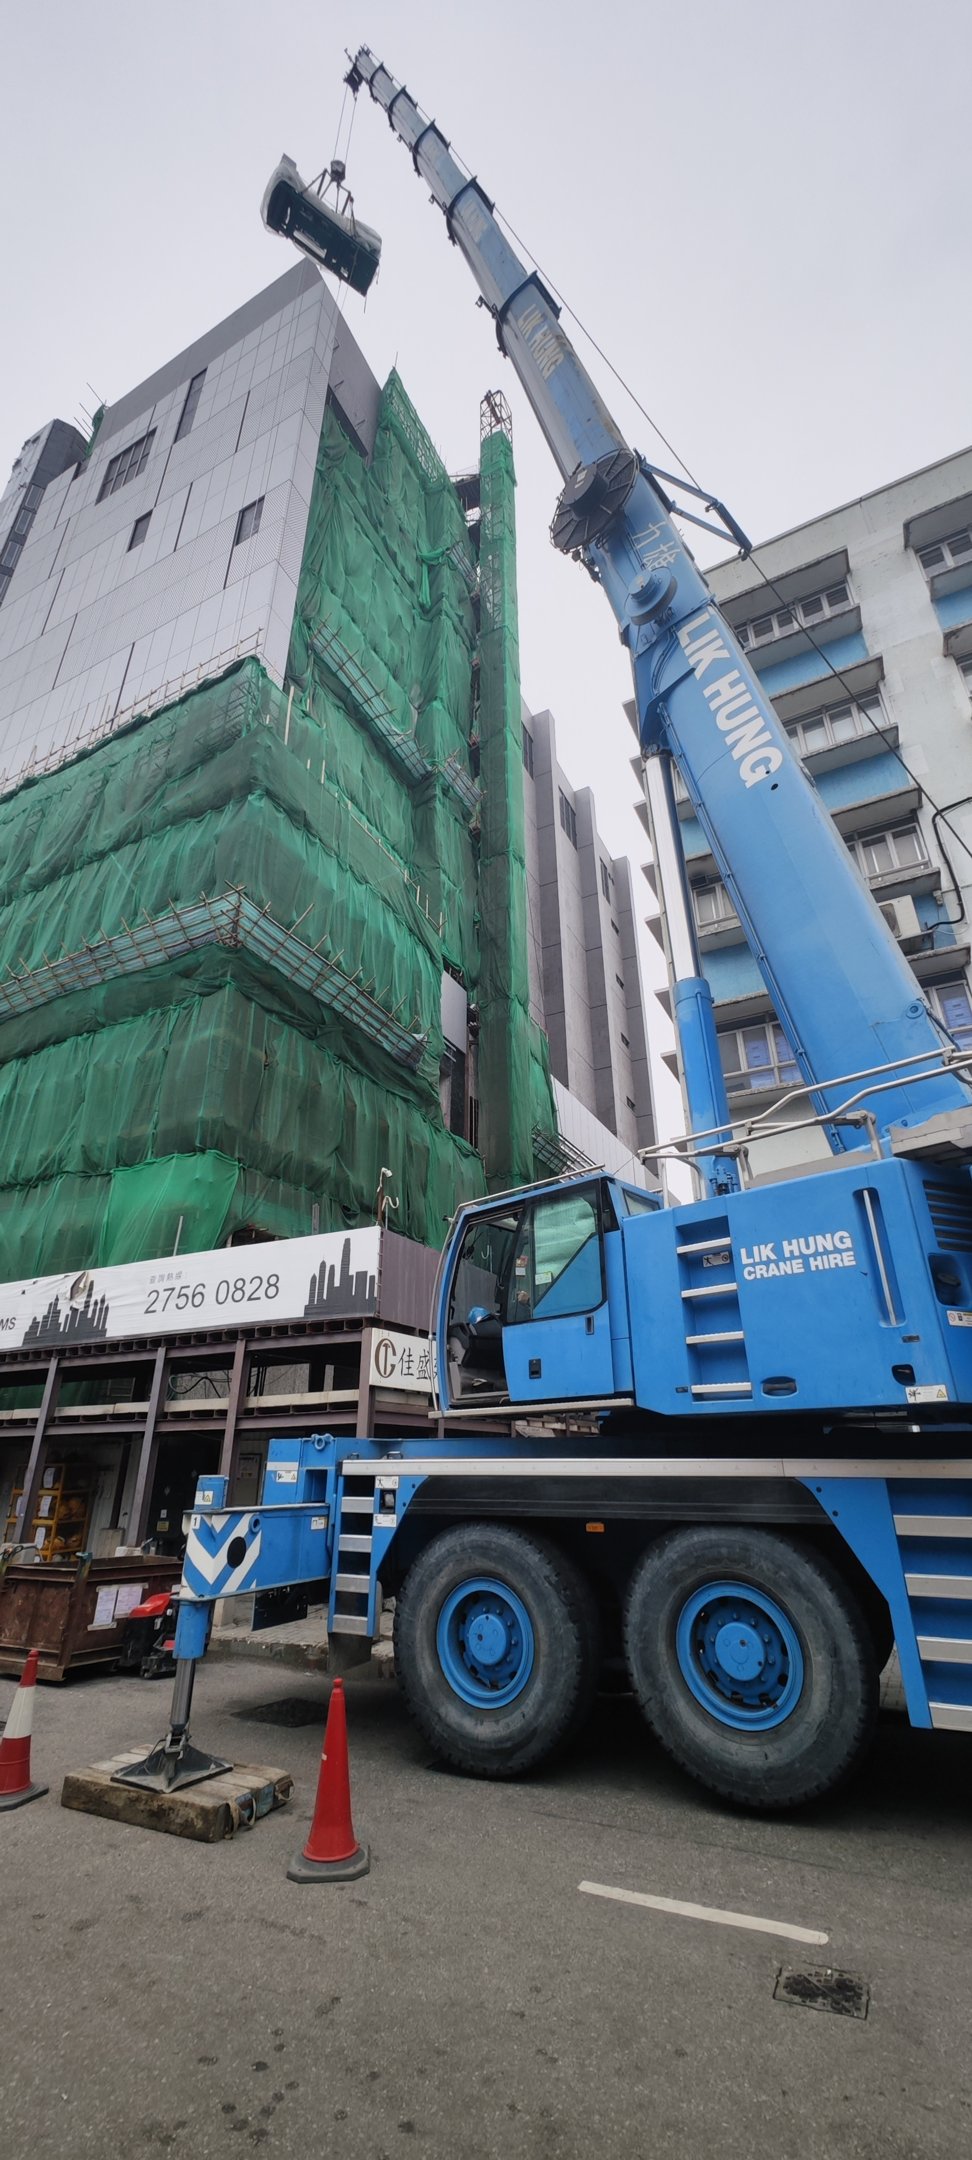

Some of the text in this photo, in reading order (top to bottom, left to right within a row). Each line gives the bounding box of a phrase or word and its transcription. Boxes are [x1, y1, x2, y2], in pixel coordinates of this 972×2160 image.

[517, 303, 565, 380] LIK HUNG
[677, 611, 783, 789] LIK HUNG
[740, 1230, 853, 1265] LIK HUNG
[743, 1251, 857, 1281] CRANE HIRE
[144, 1273, 280, 1314] 2756 0828
[398, 1347, 438, 1381] 佳盛
